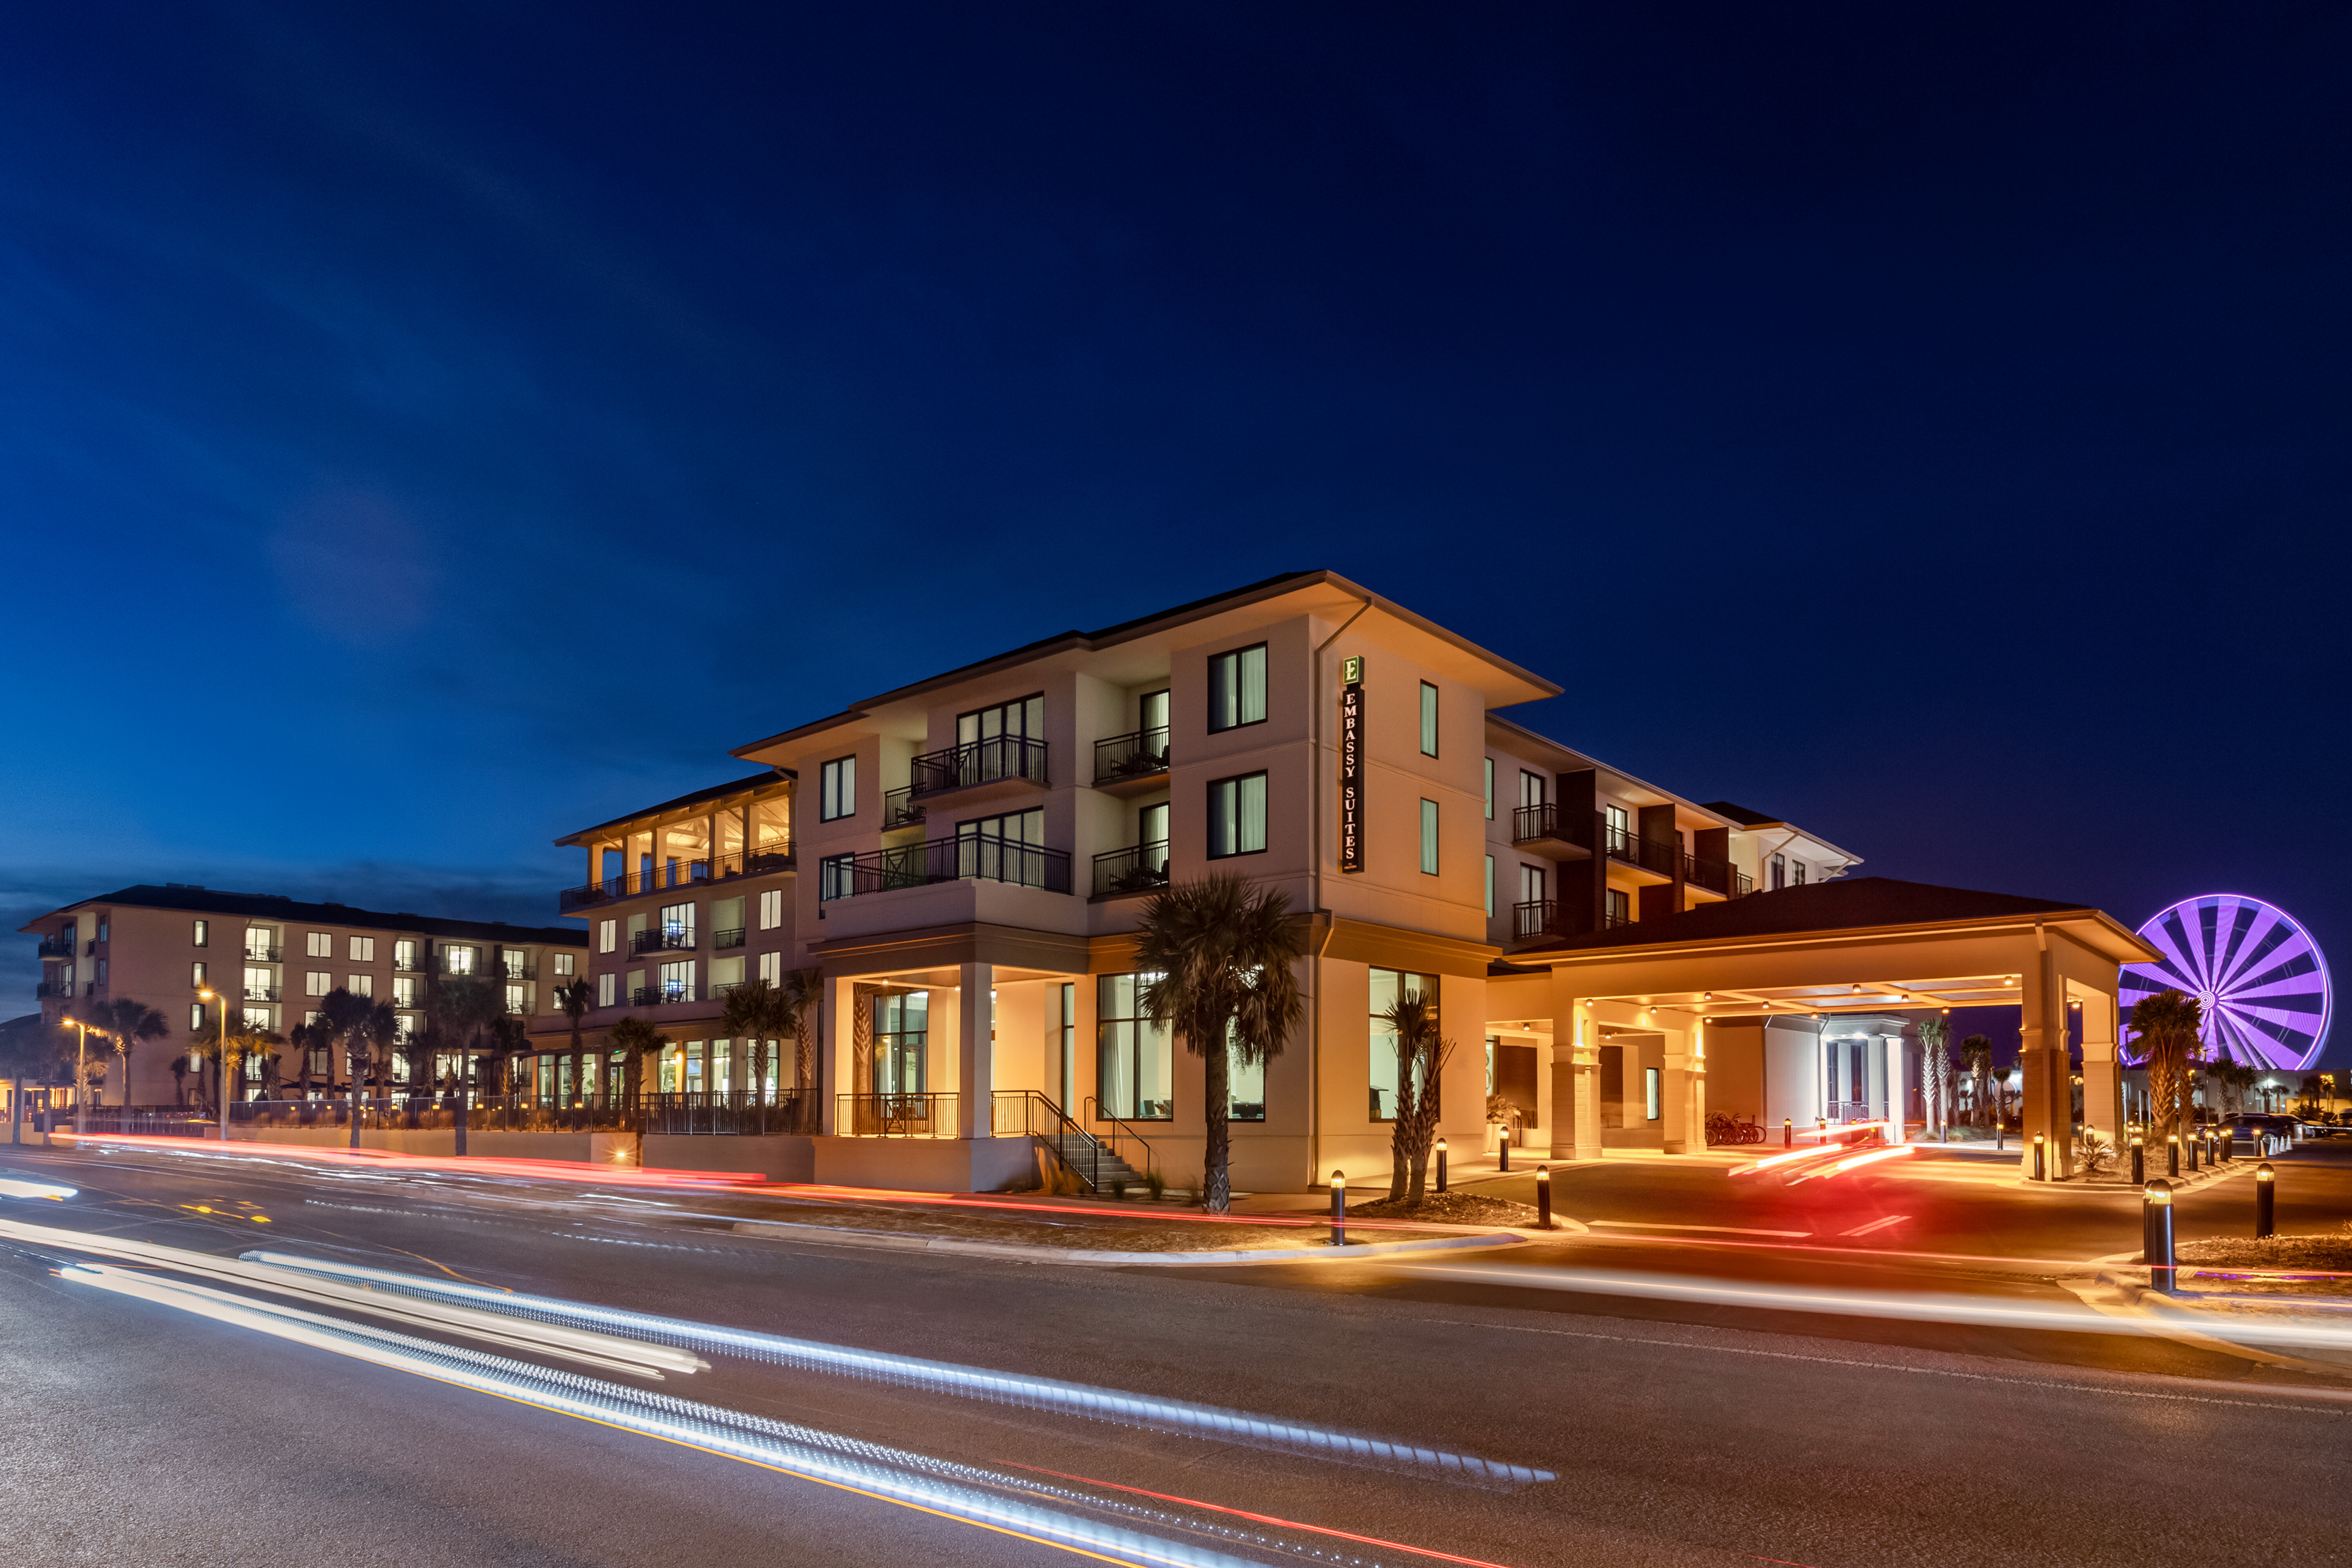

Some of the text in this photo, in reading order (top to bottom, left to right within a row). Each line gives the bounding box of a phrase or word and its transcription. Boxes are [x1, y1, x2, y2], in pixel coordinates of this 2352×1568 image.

[1346, 660, 1356, 681] E
[1344, 693, 1357, 859] EMBASSY SUITES
